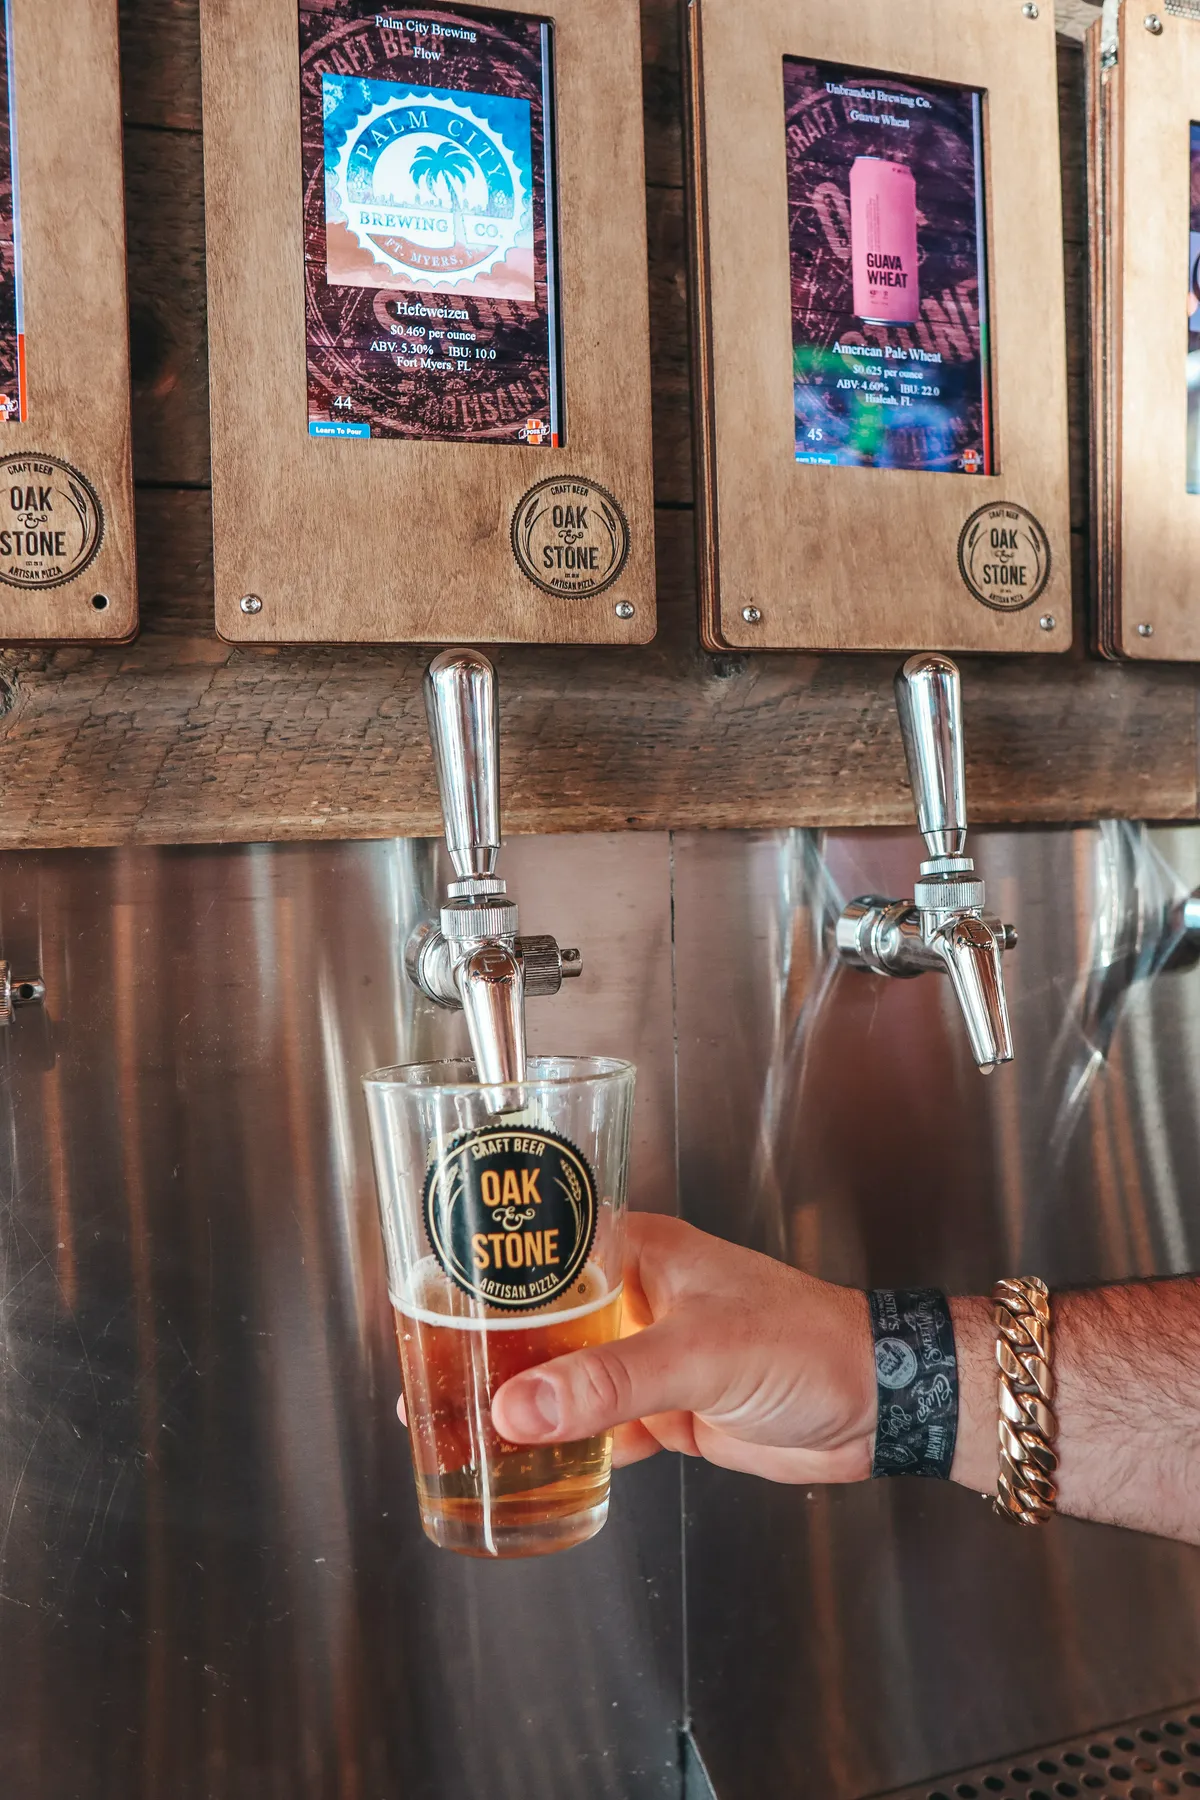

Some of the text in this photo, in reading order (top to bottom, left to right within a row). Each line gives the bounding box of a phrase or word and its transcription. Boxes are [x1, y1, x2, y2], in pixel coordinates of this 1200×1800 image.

[375, 15, 477, 42] Palm City Brewing
[413, 46, 441, 61] Flow
[826, 83, 932, 109] Unbranded Brewing Co.
[850, 110, 880, 124] Guava
[881, 115, 909, 129] Wheat
[356, 110, 506, 180] PALM CITY
[359, 211, 503, 238] BREWING CO.
[866, 253, 902, 271] GUAVA
[867, 270, 908, 288] WHEAT
[396, 302, 470, 320] Hefeweizen
[390, 324, 476, 341] $0.469 per ounce
[370, 341, 497, 360] ABV: 5.30% IBU: 10.0
[832, 341, 942, 363] American Pale Wheat
[396, 355, 471, 371] Fort Myers, FL
[852, 364, 924, 380] $0.625 per ounce
[836, 378, 940, 397] ABV: 4.60% IBU: 22.0
[334, 396, 352, 410] 44
[901, 396, 913, 407] FL
[315, 426, 362, 436] Learn To Pour
[807, 429, 823, 441] 45
[8, 463, 53, 475] CRAFT BEER
[10, 485, 53, 511] OAK
[550, 484, 589, 497] CRAFT BEER
[17, 513, 48, 529] &
[553, 505, 588, 529] OAK
[0, 530, 67, 557] STONE
[558, 529, 583, 544] &
[990, 528, 1018, 549] OAK
[543, 545, 599, 570] STONE
[995, 550, 1014, 564] &
[9, 565, 63, 580] ARTISAN PIZZA
[983, 564, 1027, 586] STONE
[550, 577, 596, 590] ARTISAN PIZZA
[472, 1138, 546, 1160] CRAFT BEER
[480, 1168, 542, 1207] OAK
[492, 1206, 536, 1231] &
[471, 1229, 560, 1270] STONE
[480, 1272, 560, 1299] ARTISAN PIZZA
[924, 1424, 944, 1461] DARWIN
